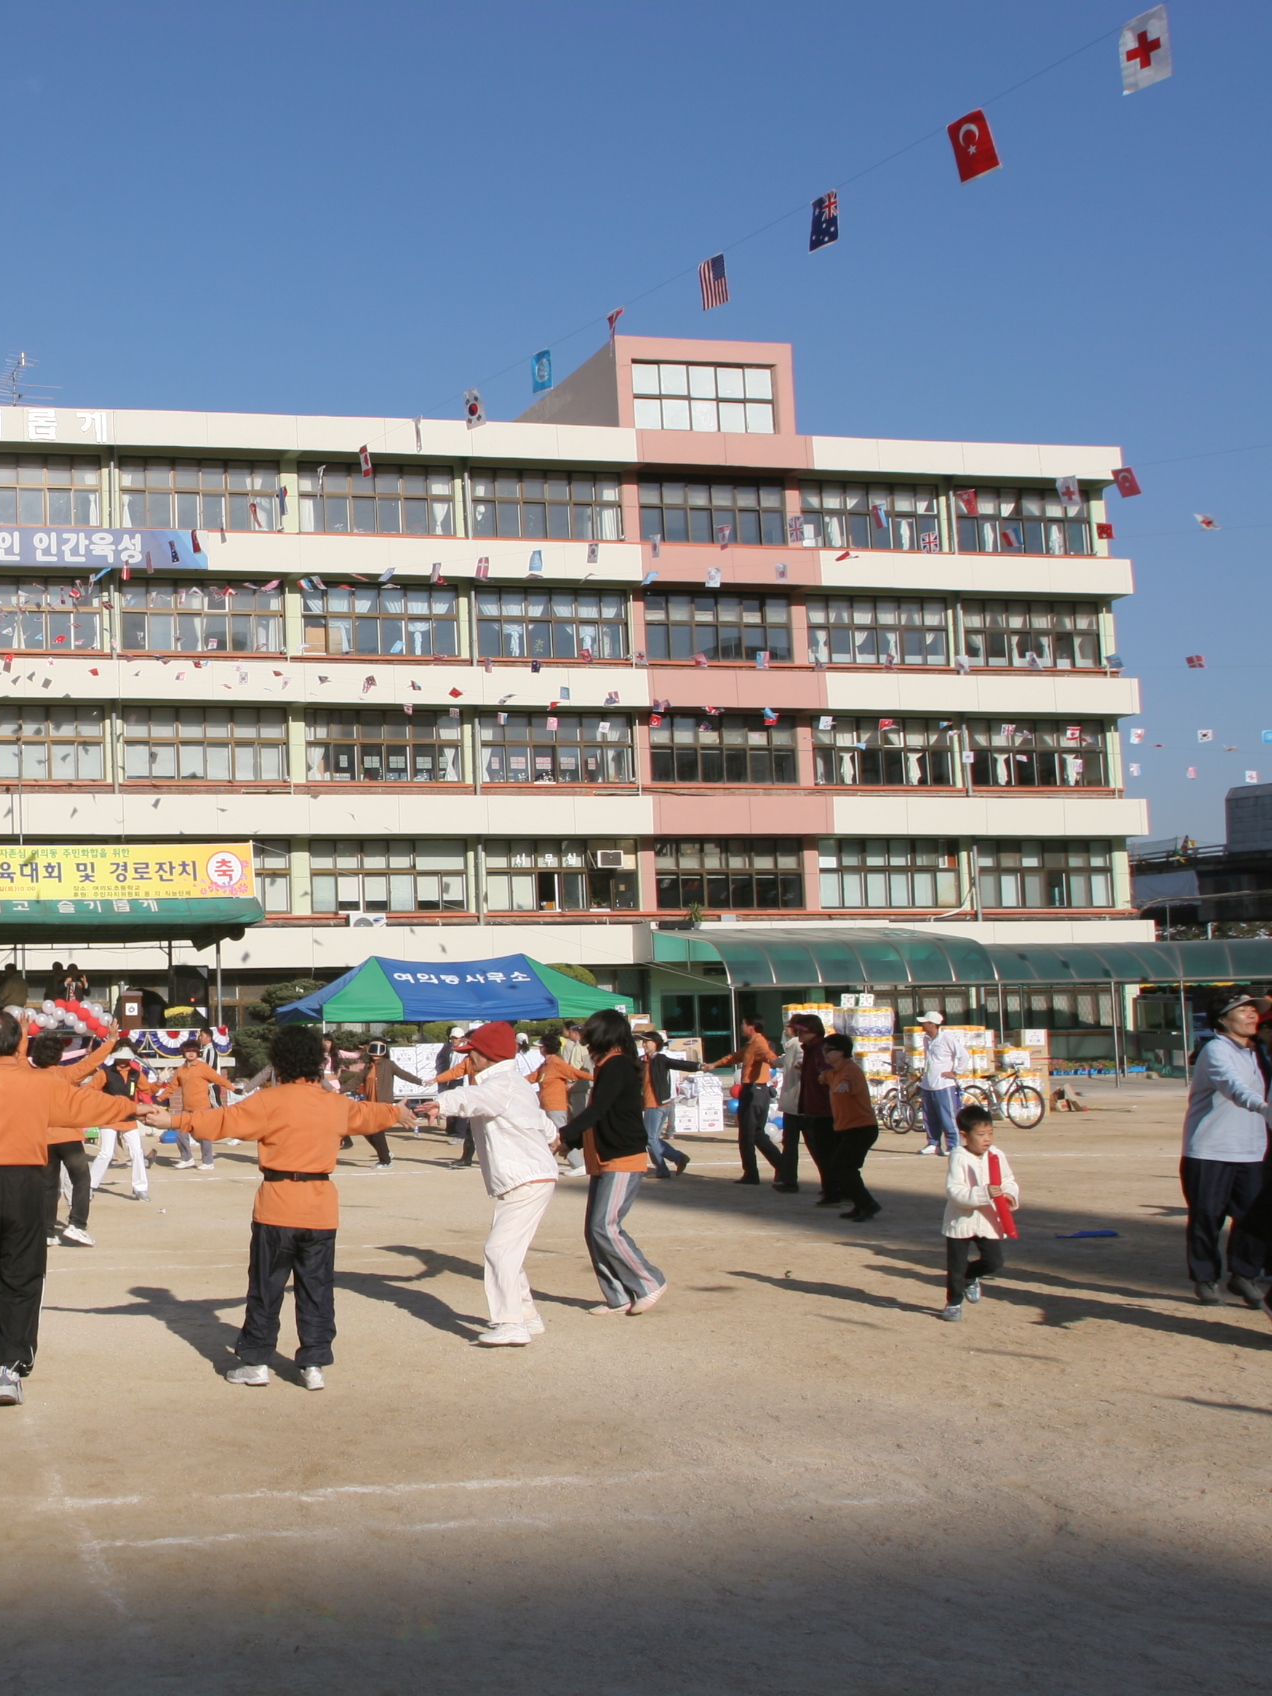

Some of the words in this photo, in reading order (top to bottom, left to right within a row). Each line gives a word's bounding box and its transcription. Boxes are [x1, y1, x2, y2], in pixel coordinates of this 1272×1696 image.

[32, 532, 143, 564] 인간육성
[0, 849, 26, 859] 자존심
[62, 848, 108, 859] 주민화합을
[112, 848, 130, 858] 위한
[75, 861, 96, 884] 및
[109, 861, 198, 884] 경로잔치
[214, 857, 235, 883] 축
[393, 971, 531, 985] 여의동사무소
